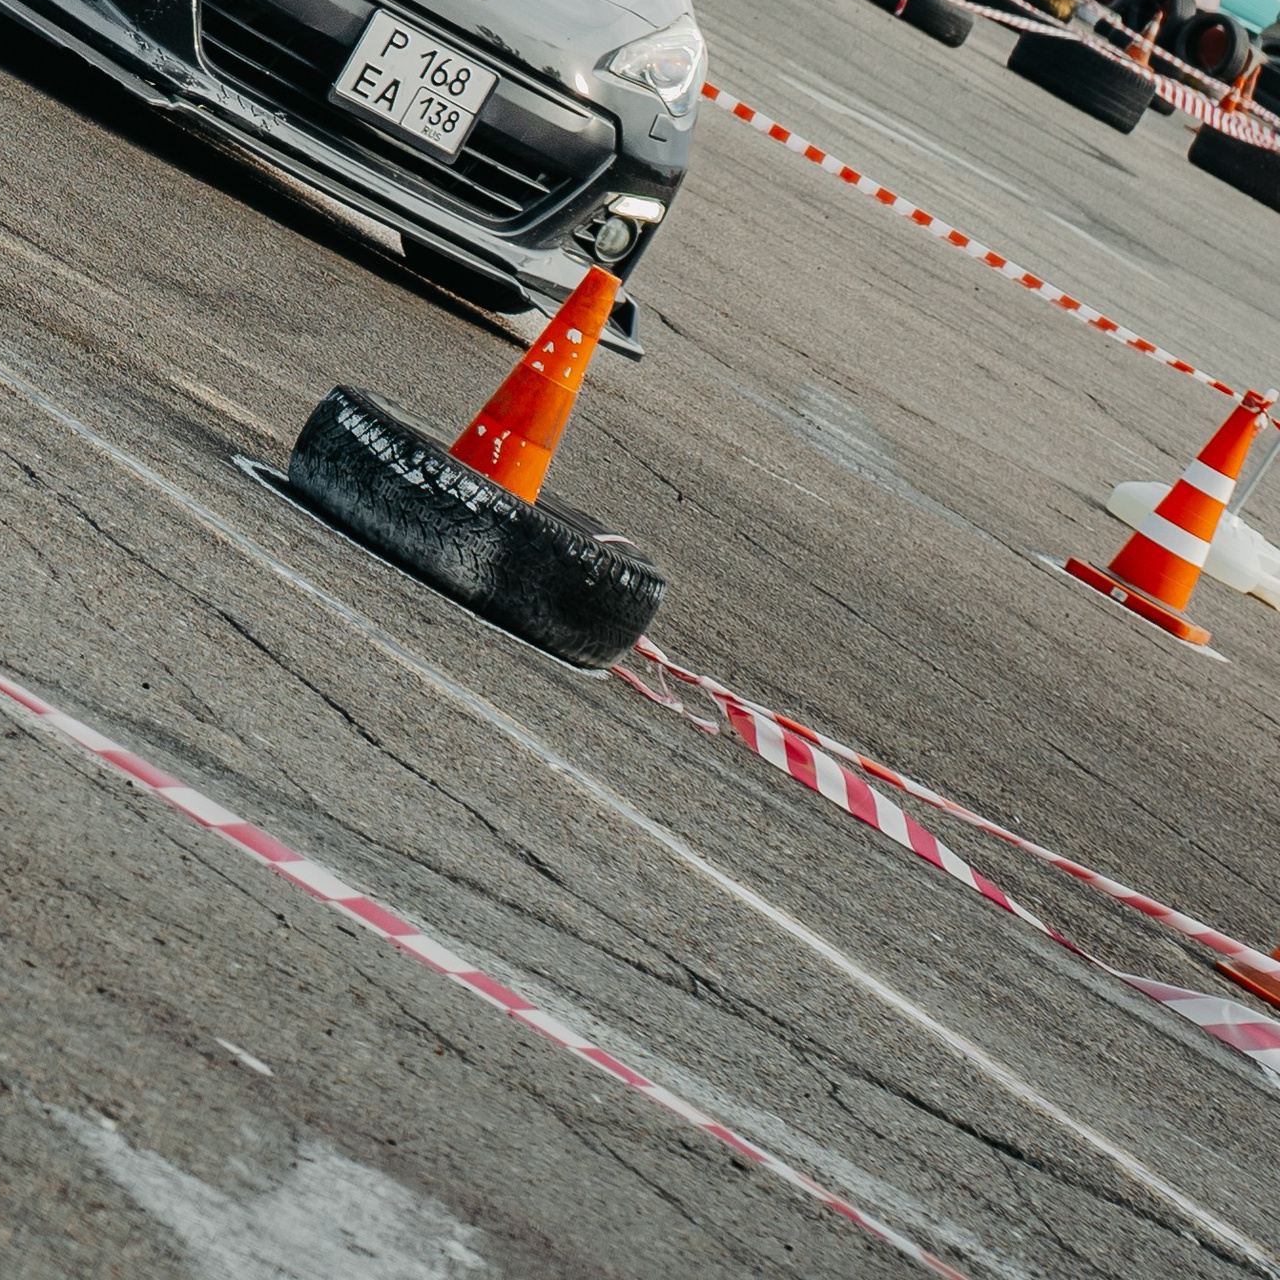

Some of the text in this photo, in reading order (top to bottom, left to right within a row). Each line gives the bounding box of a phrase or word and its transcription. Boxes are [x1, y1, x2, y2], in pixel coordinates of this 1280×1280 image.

[419, 49, 472, 97] 168
[419, 96, 461, 134] 138
[421, 125, 444, 143] RUS
